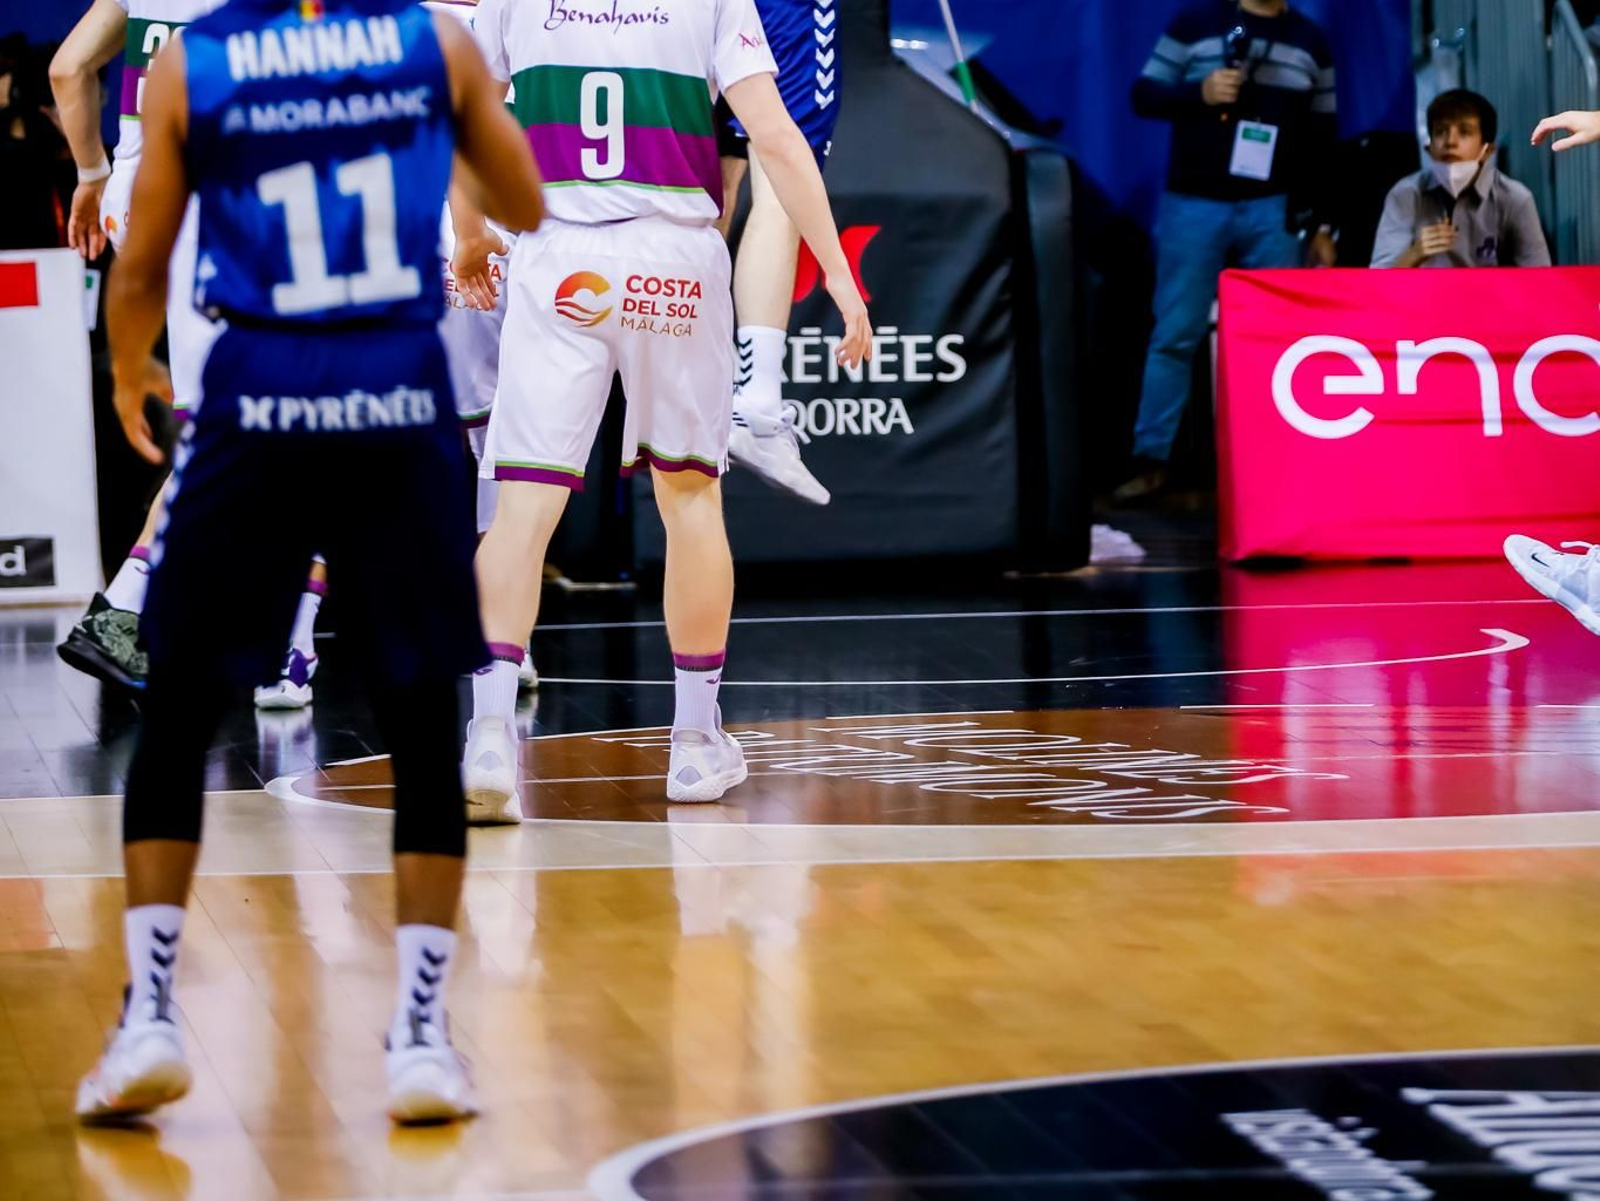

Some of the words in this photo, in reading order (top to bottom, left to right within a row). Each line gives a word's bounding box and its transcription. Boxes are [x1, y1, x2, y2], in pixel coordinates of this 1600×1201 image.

[225, 14, 403, 82] HANNAH
[249, 84, 431, 133] MORABANC
[580, 70, 625, 181] 9
[257, 152, 422, 316] 11
[622, 297, 661, 317] DEL
[665, 302, 699, 319] SOL
[625, 274, 703, 300] COSTA
[807, 719, 1353, 786] MOLINES
